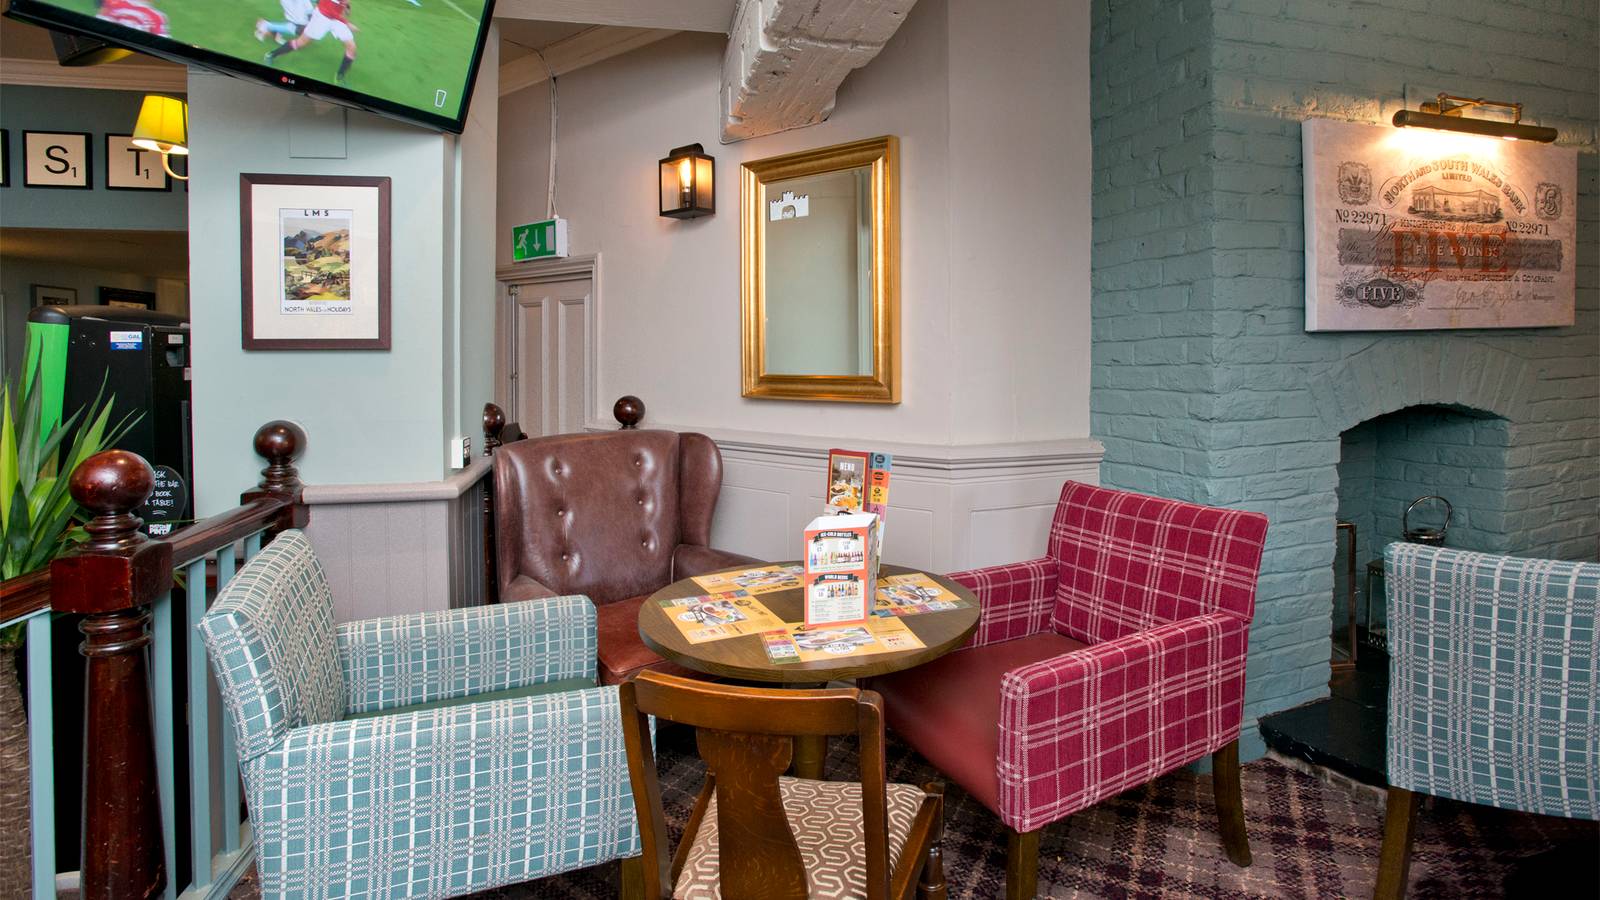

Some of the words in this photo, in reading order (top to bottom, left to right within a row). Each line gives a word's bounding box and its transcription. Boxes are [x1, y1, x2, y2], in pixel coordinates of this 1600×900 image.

[1441, 172, 1473, 183] LIMITED
[1383, 170, 1416, 205] NORTH
[1415, 165, 1432, 179] AND
[1431, 159, 1469, 172] SOUTH
[1471, 161, 1504, 188] WALES
[1501, 182, 1527, 214] BANK
[1351, 210, 1387, 226] 22971
[1519, 222, 1550, 236] 22971
[1390, 230, 1508, 273] FIVE
[1416, 244, 1444, 257] FIVE
[1450, 246, 1500, 258] POUNDS
[1361, 286, 1401, 301] FIVE
[840, 462, 855, 471] MENU
